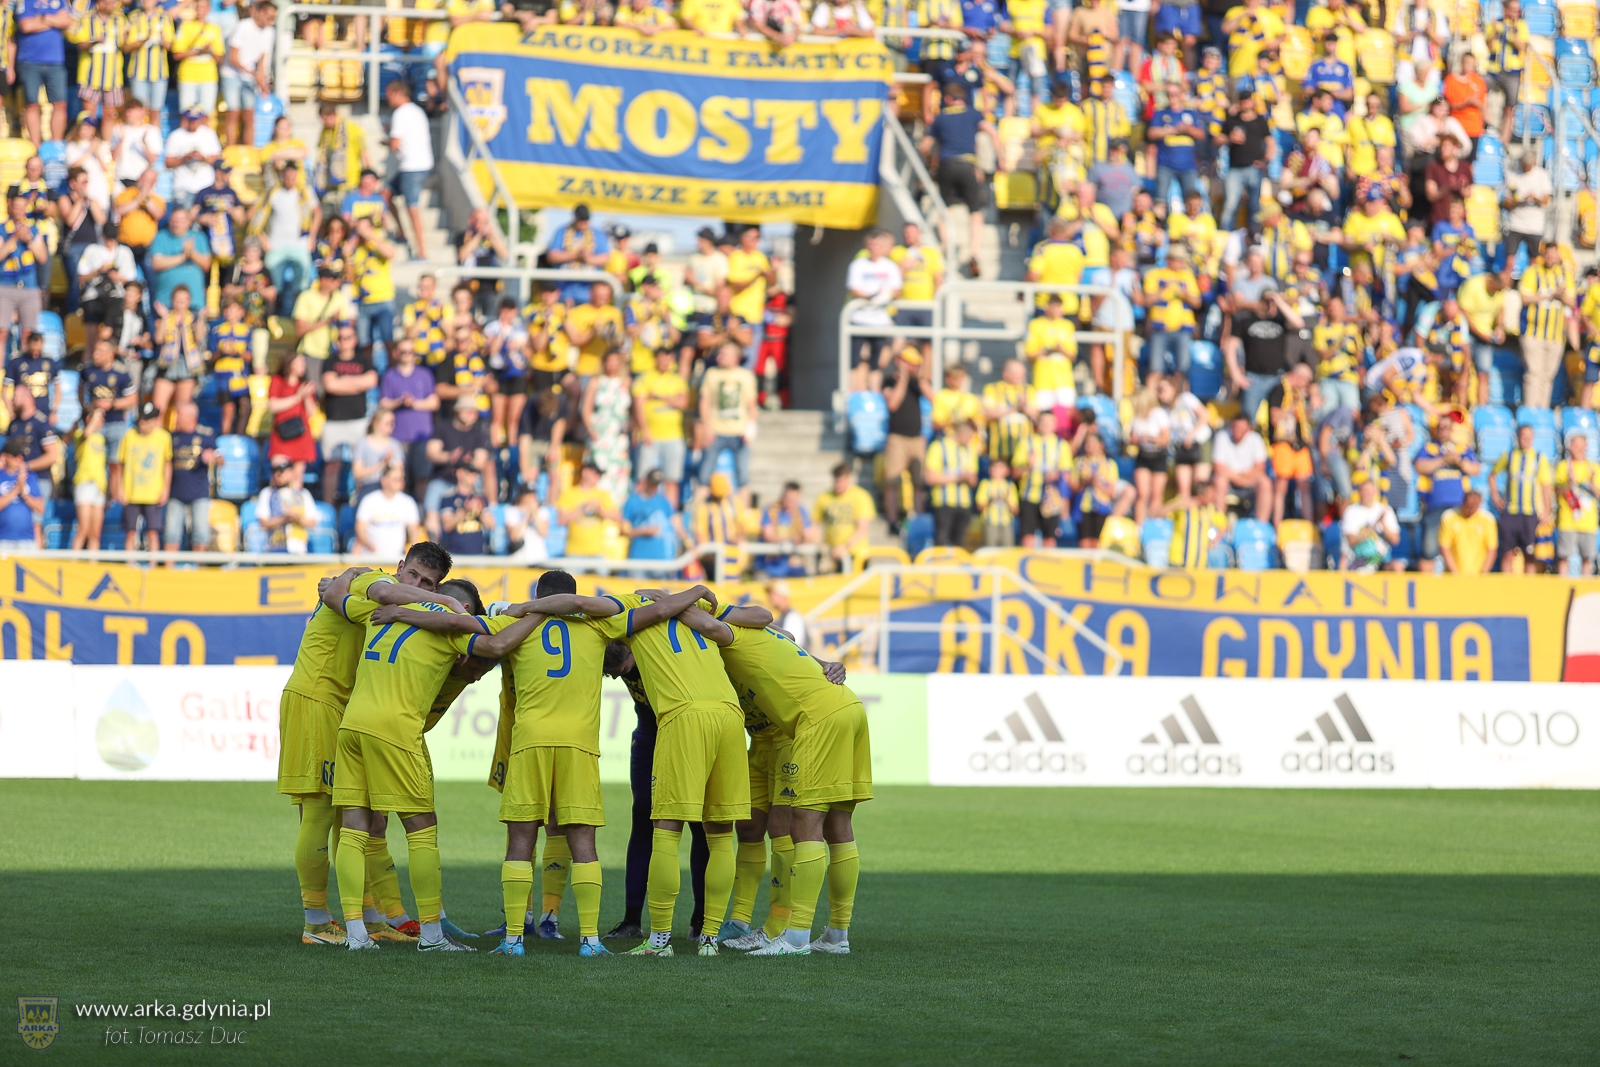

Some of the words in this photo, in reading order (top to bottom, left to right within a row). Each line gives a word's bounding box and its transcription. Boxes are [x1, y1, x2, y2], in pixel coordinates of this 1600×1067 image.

[519, 30, 709, 66] ZAGORZALI
[727, 50, 891, 71] FANATYCY
[525, 77, 883, 165] MOSTY
[557, 175, 686, 205] ZAWSZE
[702, 189, 719, 206] Z
[735, 190, 825, 208] WAMI
[541, 619, 572, 678] 9
[936, 597, 1152, 677] ARKA
[1202, 616, 1494, 681] GDYNIA
[1458, 710, 1580, 747] NO10
[969, 747, 1087, 774] adidas
[1126, 749, 1242, 776] adidas
[1281, 746, 1395, 774] adidas
